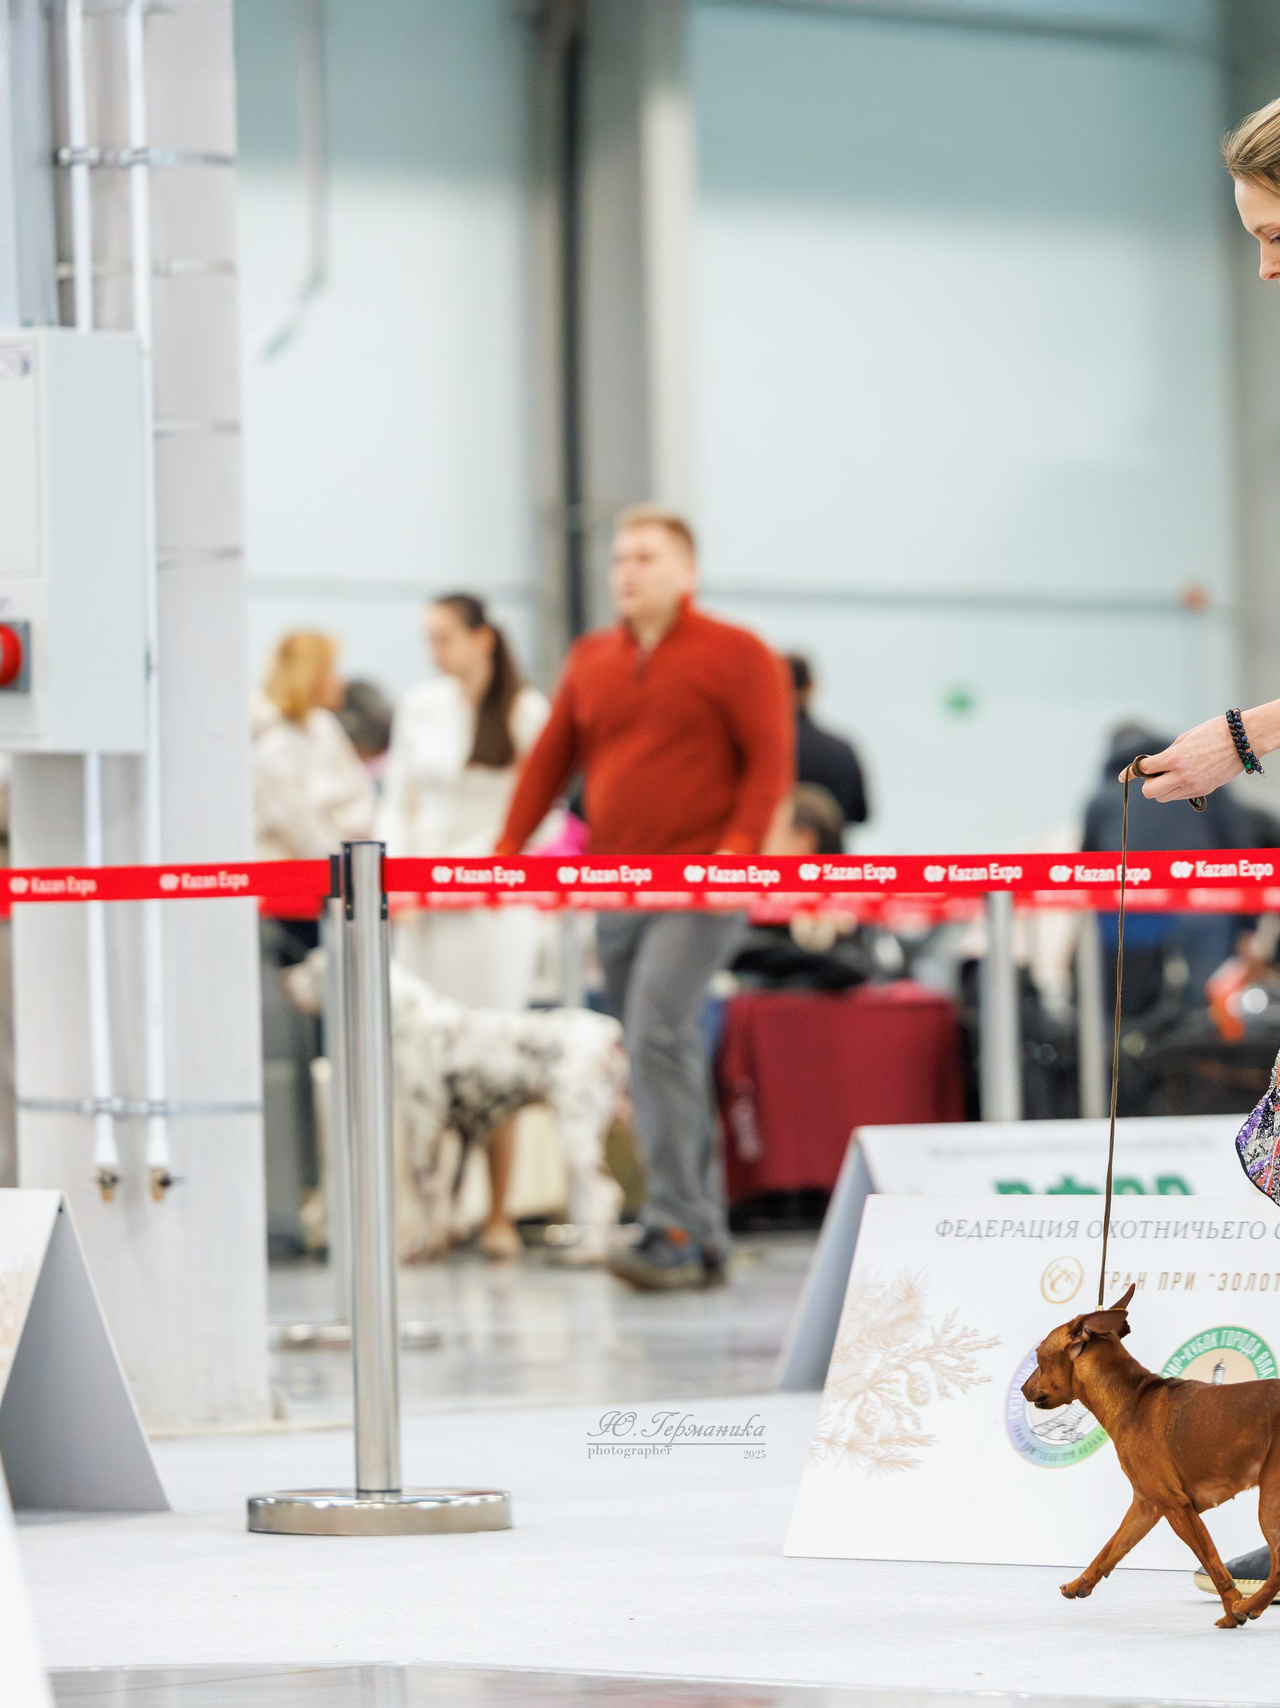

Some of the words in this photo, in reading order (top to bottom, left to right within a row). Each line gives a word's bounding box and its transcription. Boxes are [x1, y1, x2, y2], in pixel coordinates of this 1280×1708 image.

[455, 866, 492, 884] Kazan
[493, 866, 526, 887] Expo
[581, 866, 619, 884] Kazan
[620, 865, 652, 886] Expo
[708, 866, 746, 883] Kazan
[747, 866, 780, 887] Expo
[948, 865, 988, 881] Kazan
[989, 863, 1022, 883] Expo
[1074, 865, 1115, 882] Kazan
[1196, 861, 1238, 877] Kazan
[1239, 860, 1273, 880] Expo
[935, 1218, 1080, 1241] ФЕДЕРАЦИЯ
[1086, 1219, 1267, 1241] ОХОТНИЧЬЕГО
[1101, 1271, 1148, 1291] РАН
[1157, 1271, 1197, 1291] ПРИ
[1183, 1331, 1219, 1361] КУБОК
[1220, 1329, 1262, 1358] ГОРОДА
[1253, 1350, 1277, 1380] ВЛА
